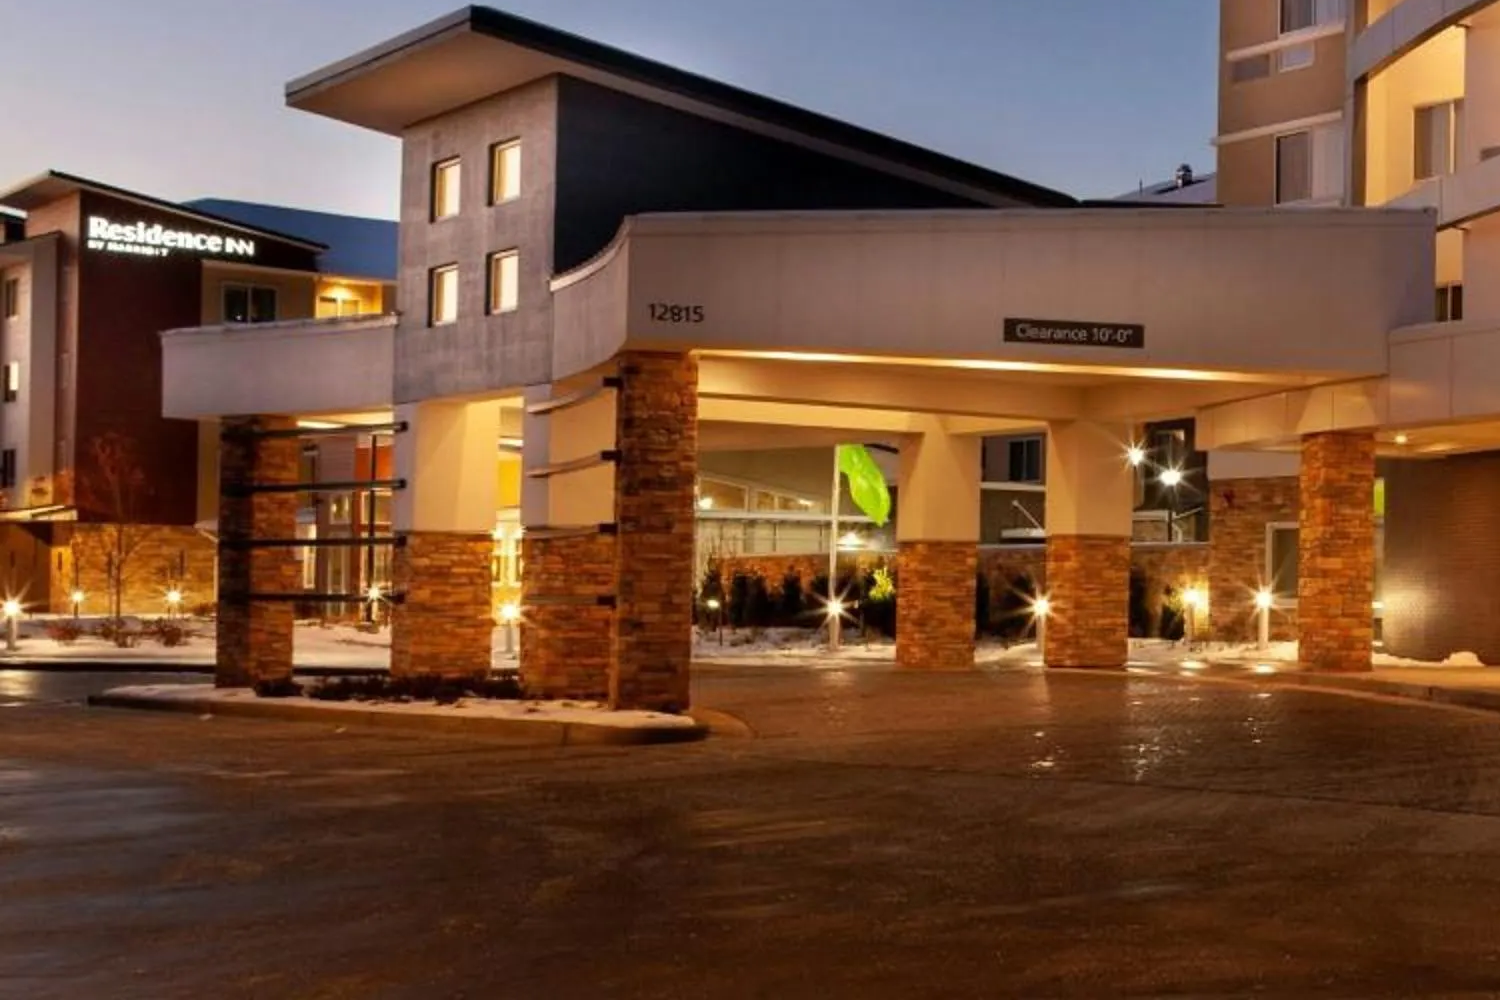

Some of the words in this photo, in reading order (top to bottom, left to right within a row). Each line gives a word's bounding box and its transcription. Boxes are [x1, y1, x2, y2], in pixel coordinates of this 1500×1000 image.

[88, 216, 222, 252] Residence
[648, 303, 705, 323] 12815
[1016, 323, 1088, 341] Clearance
